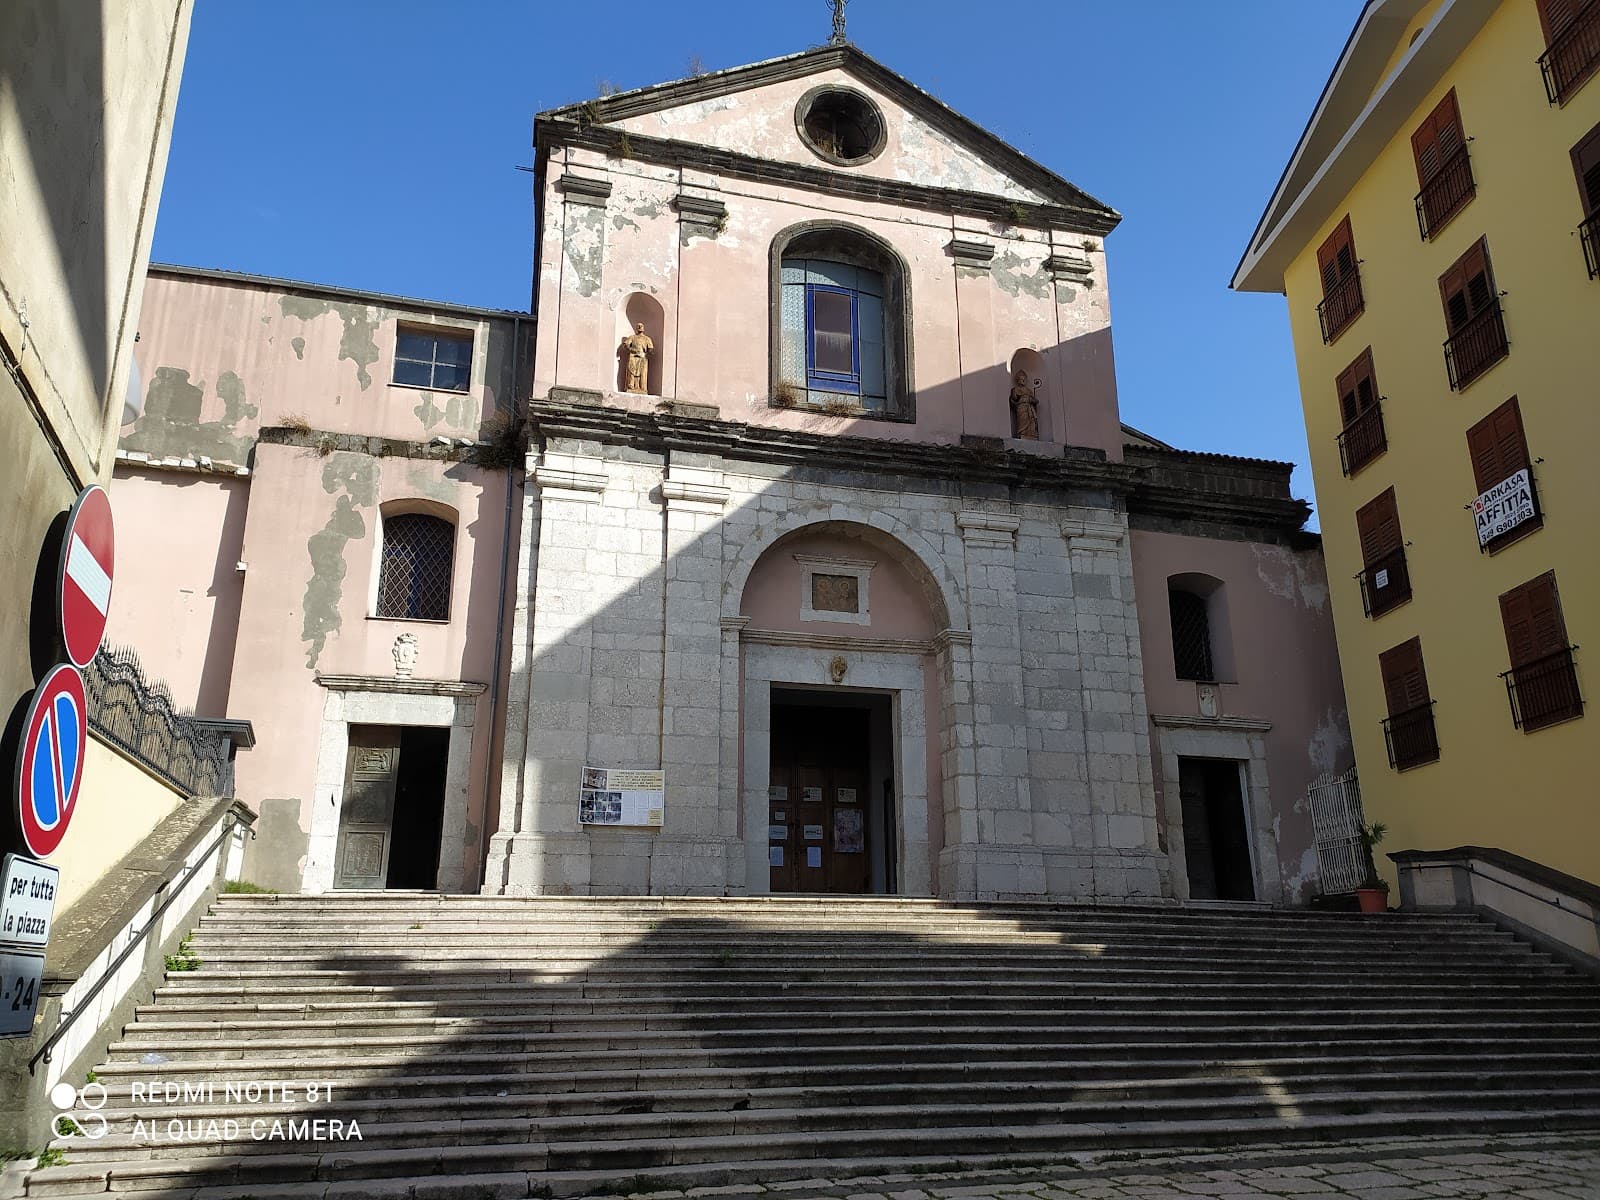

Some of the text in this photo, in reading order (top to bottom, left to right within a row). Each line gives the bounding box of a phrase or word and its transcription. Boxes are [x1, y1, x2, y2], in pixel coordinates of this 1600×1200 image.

[1484, 473, 1524, 505] ARKASA
[1478, 488, 1531, 530] AFFITTA
[9, 876, 54, 901] per tutta
[3, 908, 46, 937] la piazza
